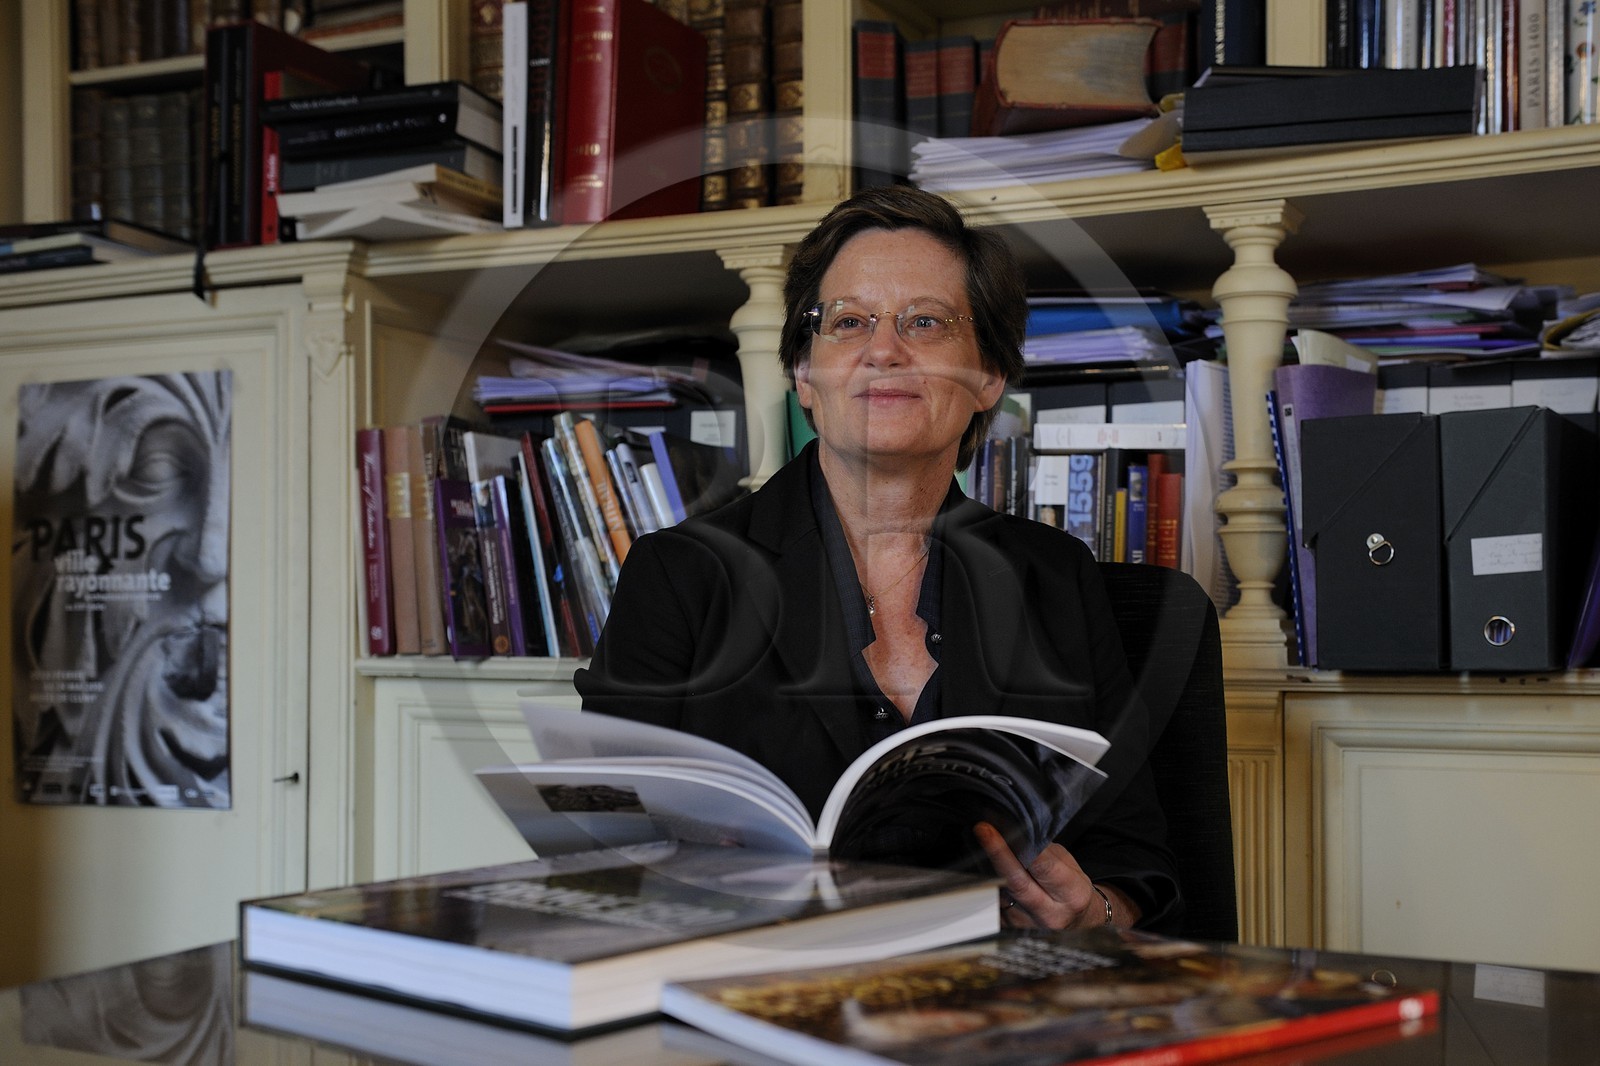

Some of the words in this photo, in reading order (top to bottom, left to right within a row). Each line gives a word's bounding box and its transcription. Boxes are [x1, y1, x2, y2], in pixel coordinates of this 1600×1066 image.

[1068, 454, 1094, 528] 1559
[28, 515, 146, 571] PARIS
[54, 549, 99, 573] ville
[55, 568, 172, 598] rayonnante
